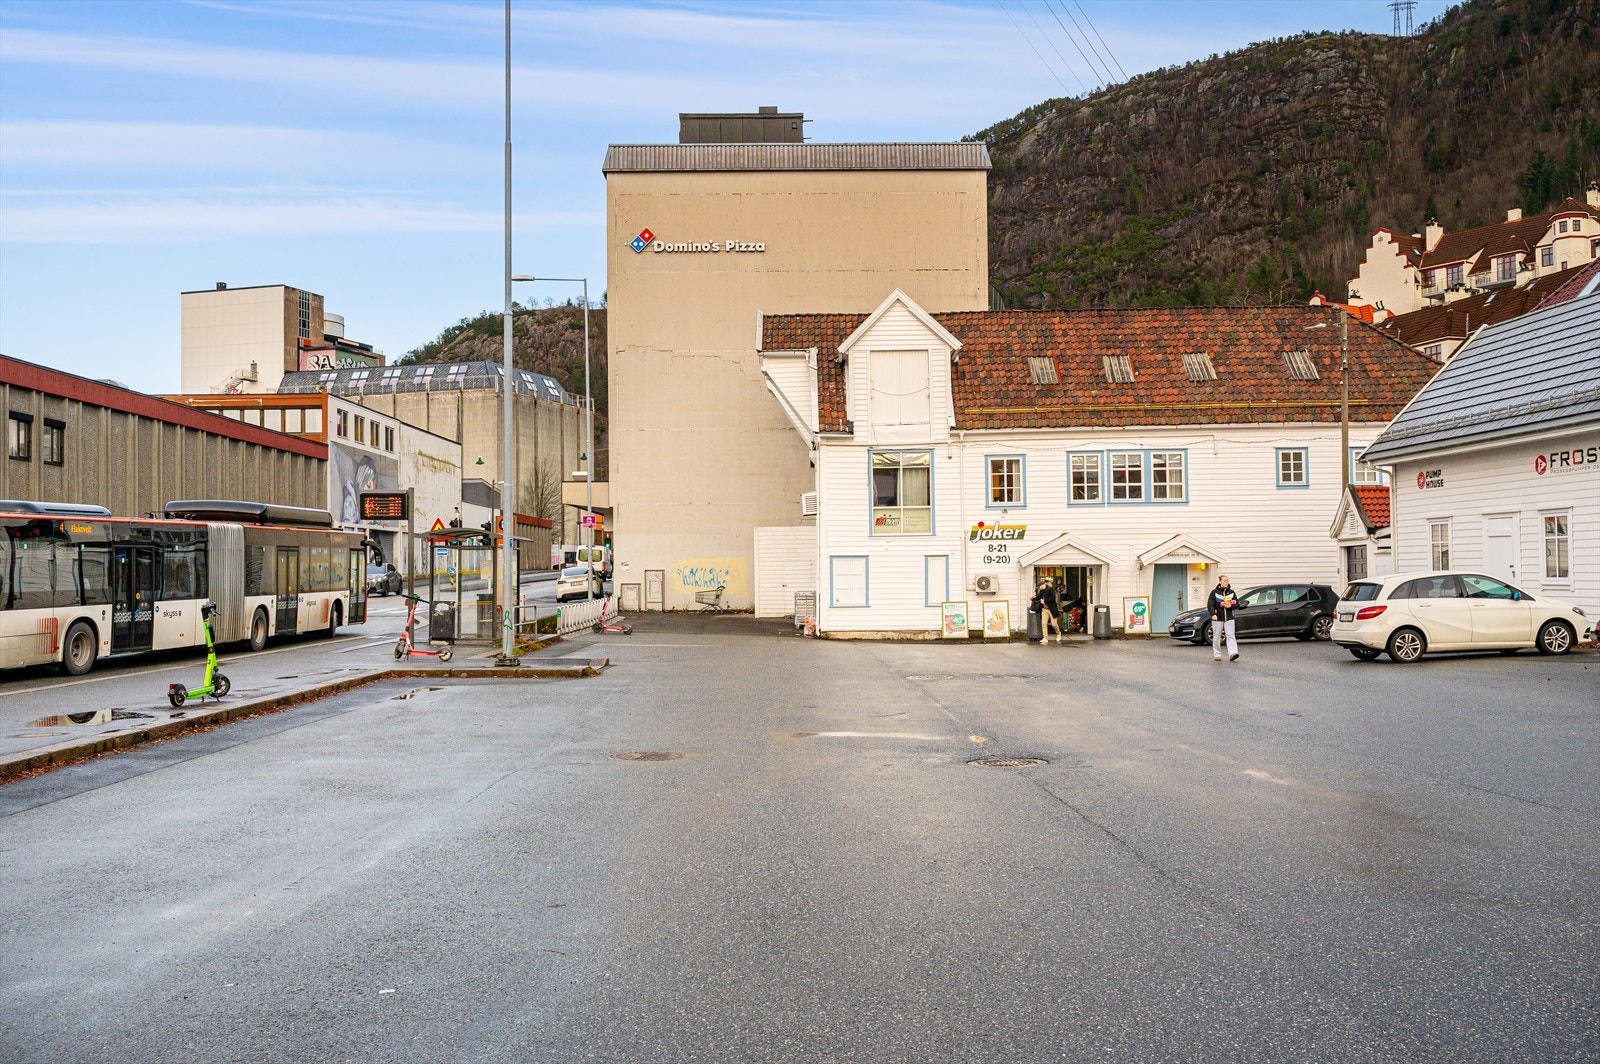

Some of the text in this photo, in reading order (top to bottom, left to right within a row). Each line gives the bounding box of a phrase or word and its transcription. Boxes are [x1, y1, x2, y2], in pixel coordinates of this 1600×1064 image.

[653, 240, 766, 253] Domino's Pizza
[1549, 447, 1600, 468] FROS
[1426, 469, 1441, 479] PUMP
[1426, 479, 1444, 489] HOUSE
[971, 521, 1023, 544] joker
[988, 544, 1007, 553] 8-21
[983, 555, 1011, 564] (9-20)
[162, 610, 179, 619] skyss
